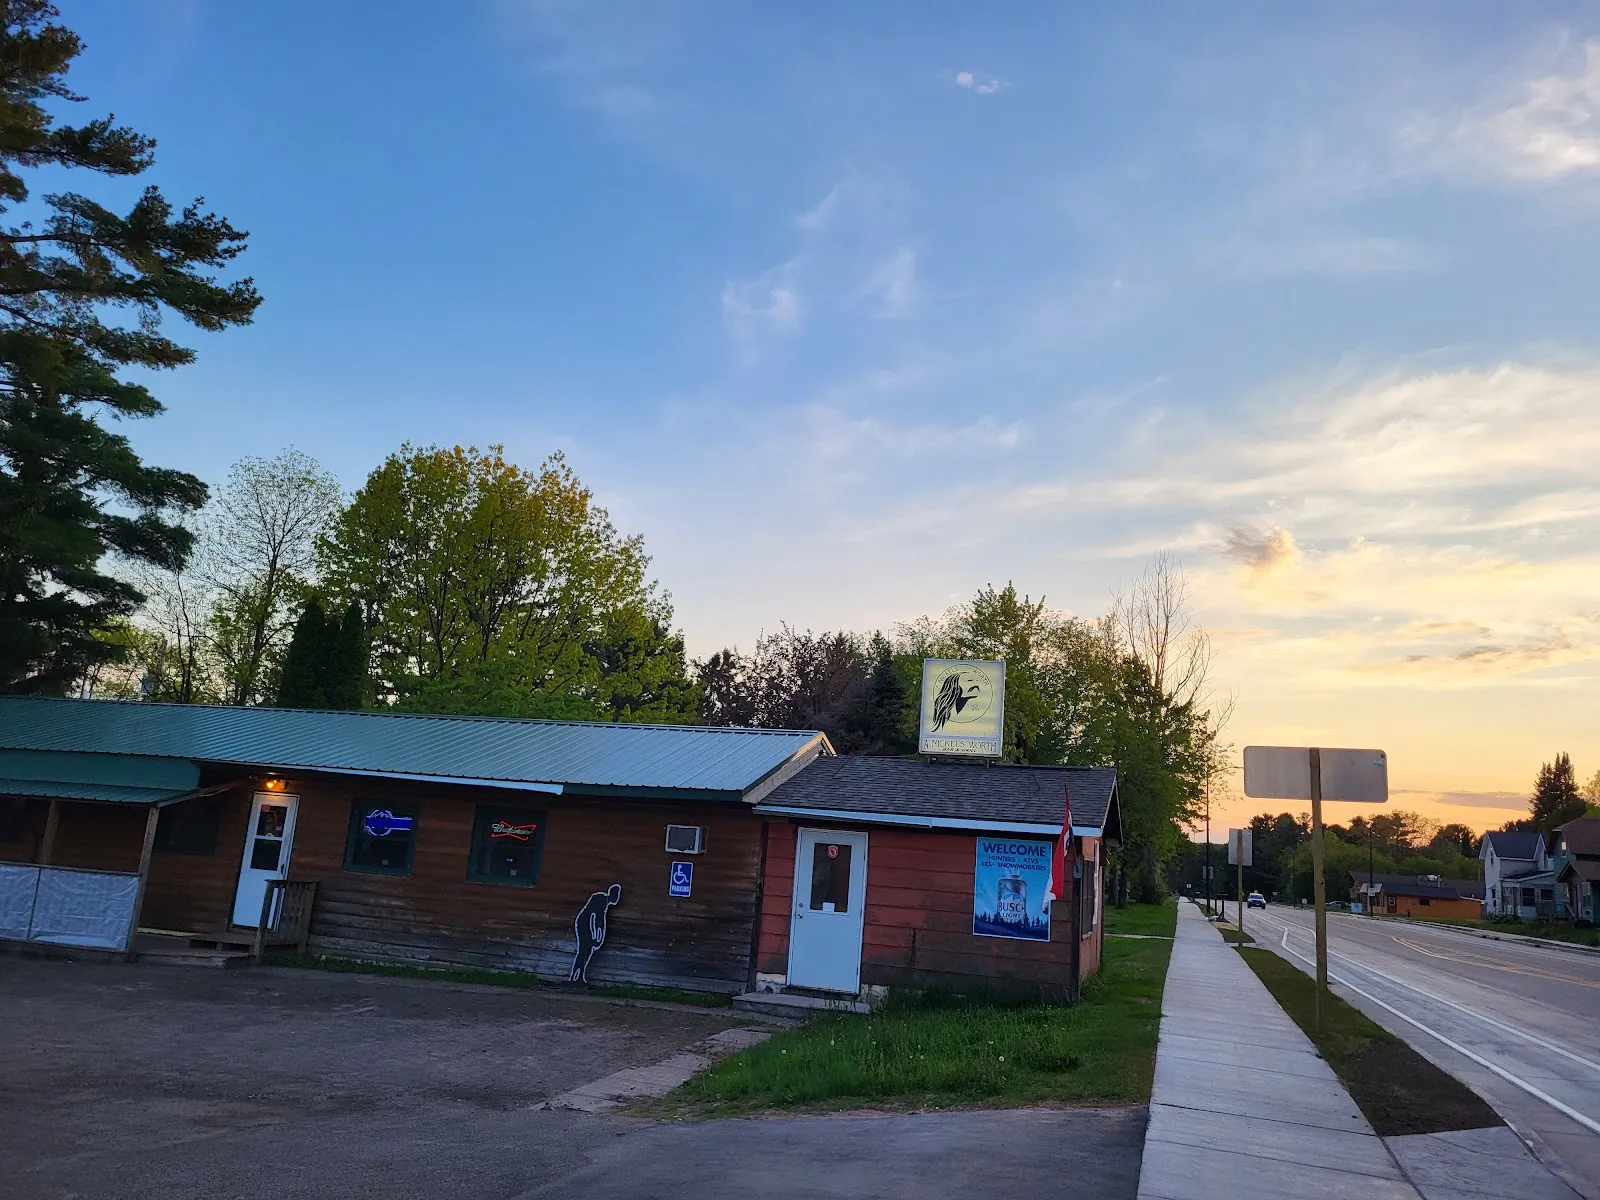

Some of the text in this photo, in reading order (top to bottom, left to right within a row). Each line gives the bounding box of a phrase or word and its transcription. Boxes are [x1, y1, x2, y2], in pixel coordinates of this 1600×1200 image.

[969, 741, 997, 752] WORTH
[982, 841, 1046, 857] WELCOME
[671, 885, 690, 893] PARKING
[998, 901, 1026, 912] BUSCH
